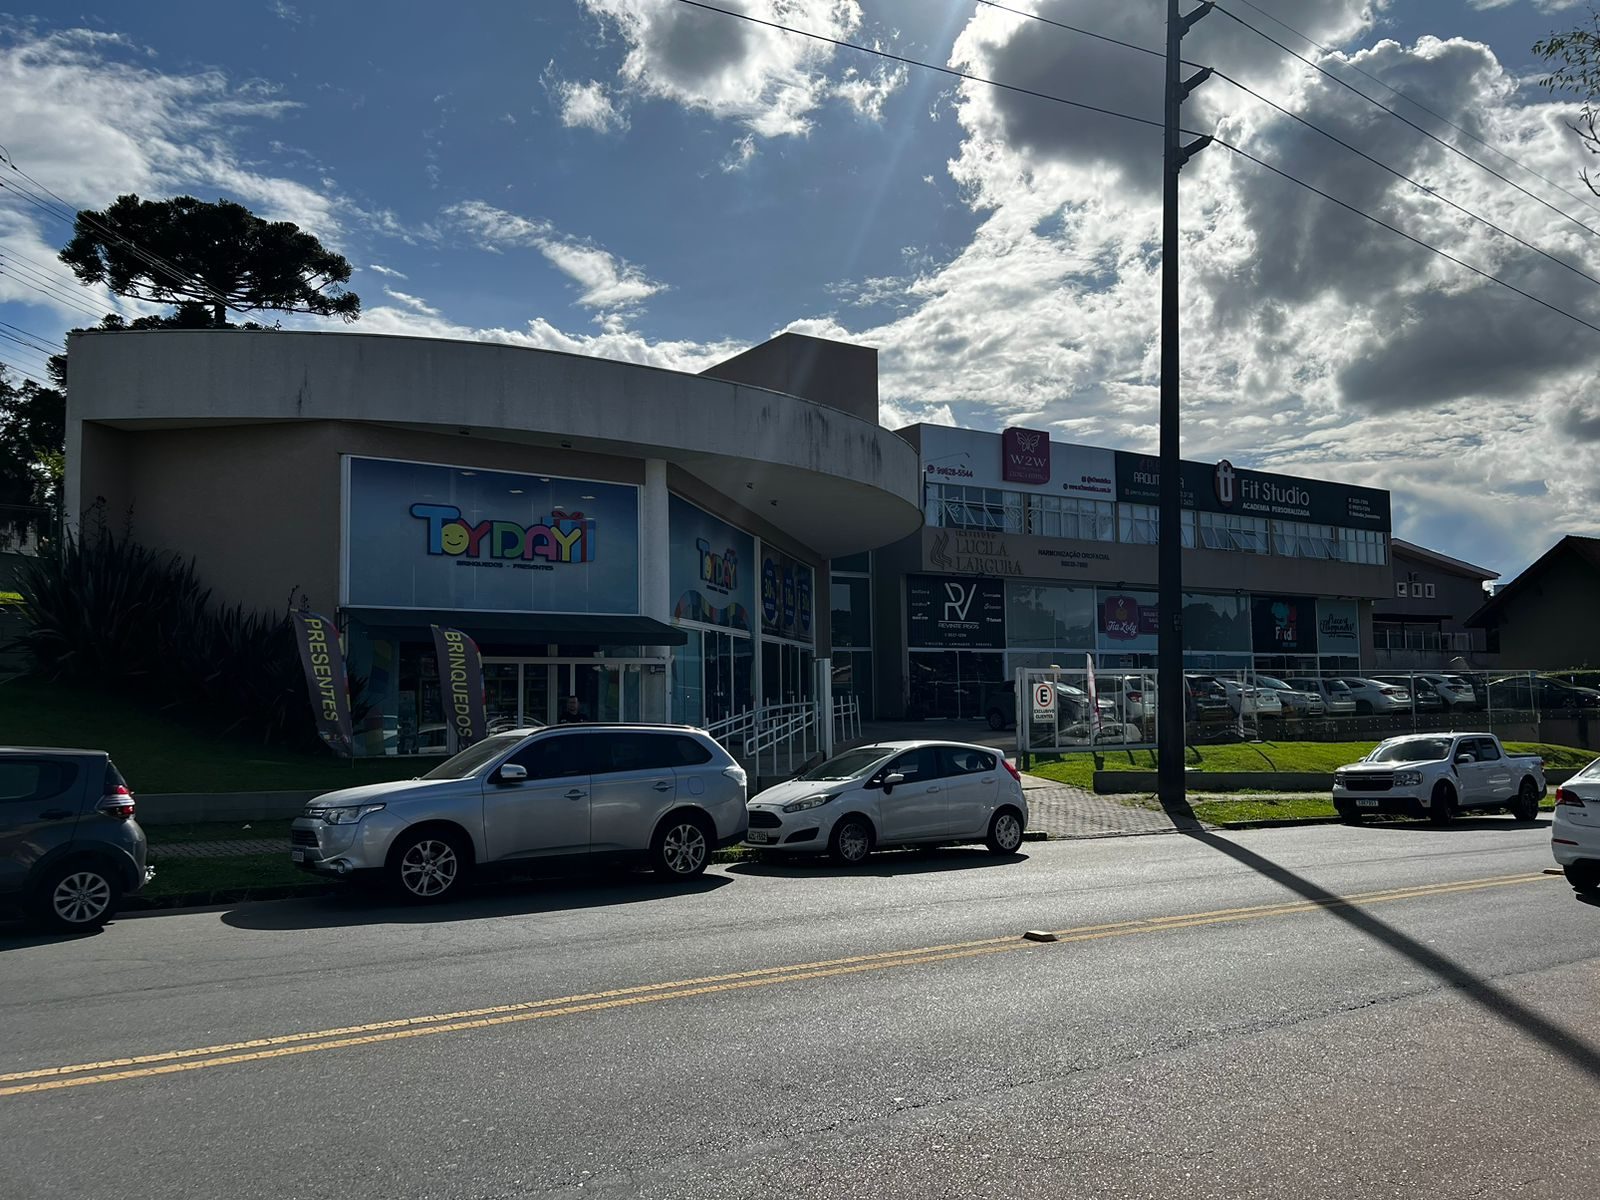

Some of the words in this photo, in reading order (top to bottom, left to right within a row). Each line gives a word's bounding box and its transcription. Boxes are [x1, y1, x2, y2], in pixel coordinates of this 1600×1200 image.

[1010, 454, 1047, 467] W2W
[1240, 479, 1260, 500] Fit
[1262, 482, 1310, 507] Studio
[1242, 502, 1270, 512] ACADEMIA
[1271, 506, 1311, 517] PERSONALIZADA
[955, 539, 1009, 557] LUCILA
[1038, 549, 1081, 560] HARMONIZAÇÃO
[1081, 552, 1110, 561] OROFACIAL
[456, 560, 504, 569] BRINQUEDOS
[512, 563, 555, 572] PRESENTES
[955, 557, 1025, 576] LARGURA
[1107, 620, 1120, 632] Tia
[1120, 620, 1138, 637] Loly
[304, 618, 339, 722] PRESENTES
[443, 630, 473, 738] BRINQUEDOS
[1040, 689, 1048, 702] E
